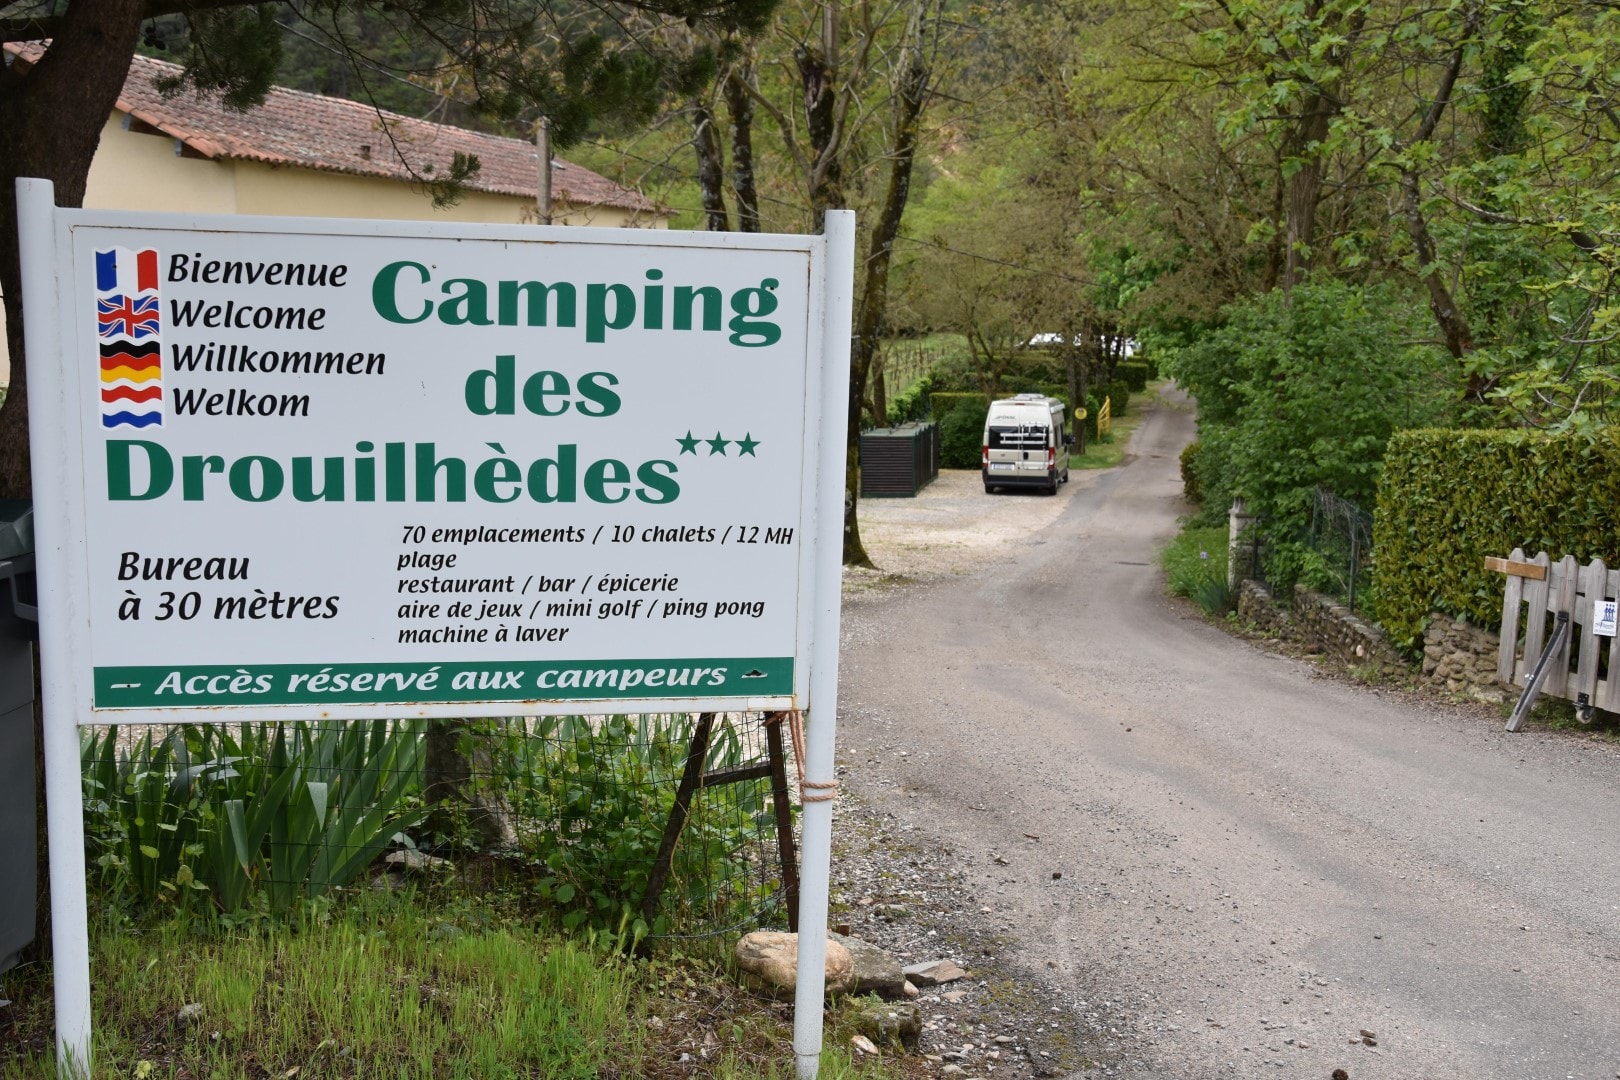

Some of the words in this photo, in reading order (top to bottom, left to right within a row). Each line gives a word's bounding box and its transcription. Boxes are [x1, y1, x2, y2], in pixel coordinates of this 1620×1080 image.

[168, 253, 347, 287] Bienvenue
[170, 299, 325, 330] Welcome
[373, 261, 781, 347] Camping
[172, 342, 385, 374] Willkommen
[466, 356, 620, 416] des
[173, 388, 309, 416] Welkom
[107, 439, 681, 504] Drouilhèdes
[403, 526, 425, 543] 70
[432, 526, 585, 545] emplacements
[593, 526, 604, 544] /
[612, 525, 634, 542] 10
[642, 526, 715, 542] chalets
[721, 526, 732, 544] /
[737, 526, 759, 543] 12
[765, 528, 793, 544] MH
[118, 552, 249, 580] Bureau
[397, 551, 456, 571] plage
[398, 576, 514, 593] restaurant
[522, 576, 533, 594] /
[539, 576, 575, 592] bar
[582, 576, 592, 594] /
[598, 573, 679, 594] épicerie
[119, 590, 141, 620] à
[155, 592, 201, 620] 30
[214, 589, 339, 619] mètres
[398, 600, 439, 618] aire
[448, 602, 472, 617] de
[475, 600, 523, 620] jeux
[530, 601, 540, 619] /
[547, 599, 592, 617] mini
[598, 600, 643, 619] golf
[647, 600, 658, 618] /
[663, 598, 708, 618] ping
[715, 602, 764, 618] pong
[399, 624, 488, 643] machine
[495, 624, 508, 642] à
[516, 626, 569, 641] laver
[154, 669, 273, 695] Accès
[288, 667, 440, 692] réservé
[452, 671, 524, 690] aux
[536, 666, 727, 690] campeurs
